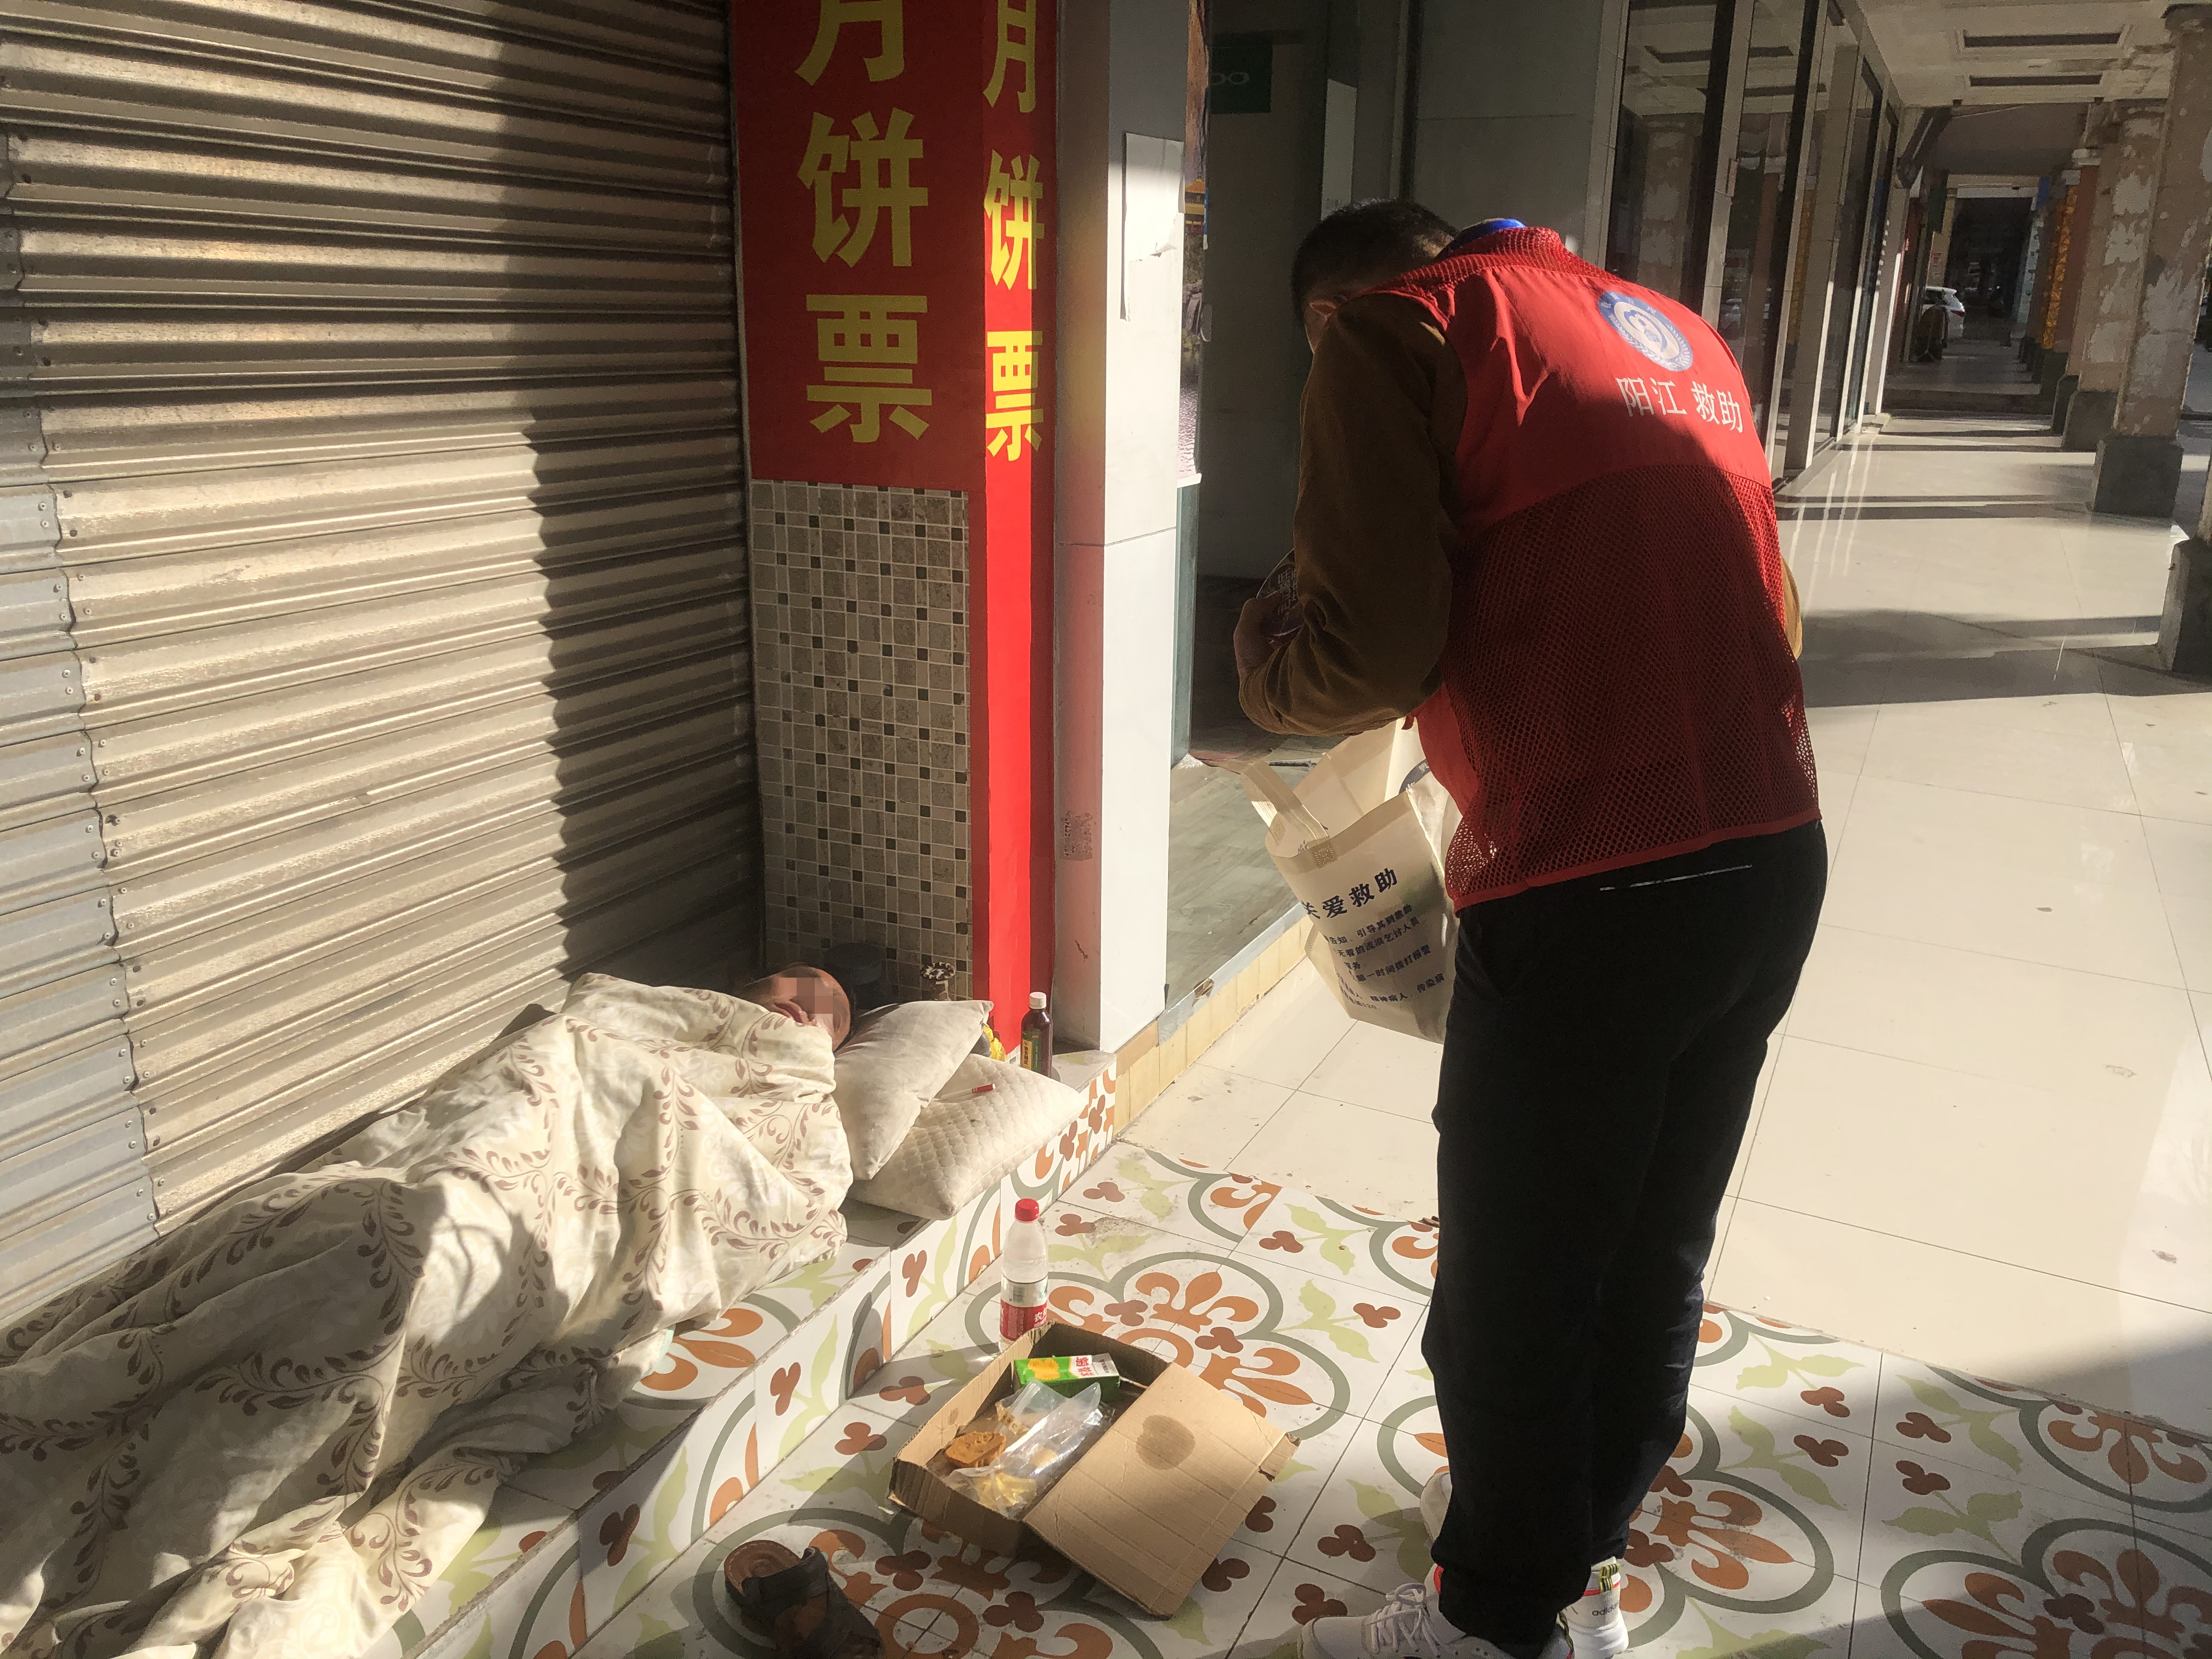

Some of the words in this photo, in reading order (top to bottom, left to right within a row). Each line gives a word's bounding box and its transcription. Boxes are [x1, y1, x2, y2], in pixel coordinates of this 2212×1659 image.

[794, 0, 932, 443] 月饼票
[983, 0, 1045, 462] 月饼票
[1616, 377, 1688, 417] 阳江
[1690, 380, 1743, 433] 救助
[1301, 867, 1398, 919] 关爱救助
[1324, 904, 1412, 945] 告知、引导其到救助
